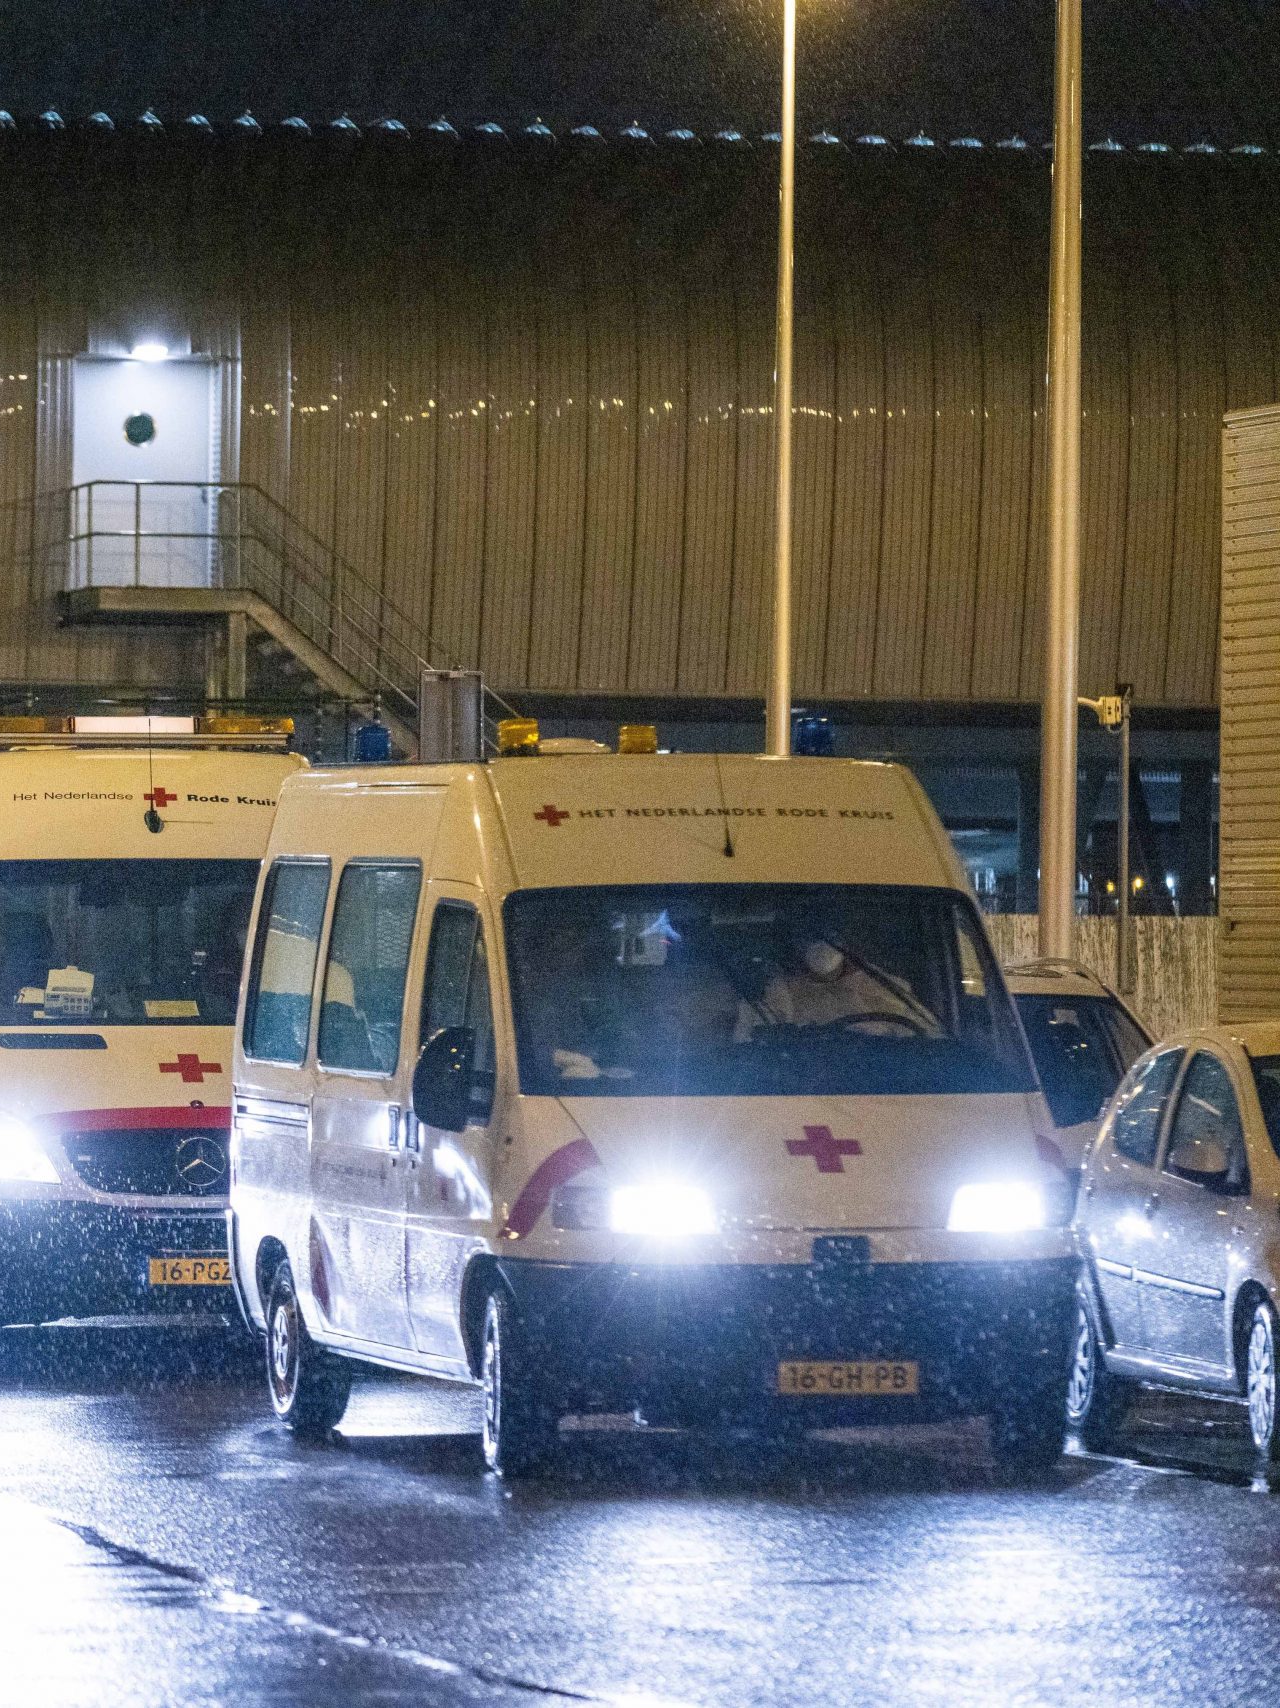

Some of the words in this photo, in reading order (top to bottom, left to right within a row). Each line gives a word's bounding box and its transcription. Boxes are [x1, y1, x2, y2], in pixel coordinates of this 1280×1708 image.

[13, 792, 38, 801] Het
[44, 791, 134, 801] Nederlandse
[187, 793, 230, 804] Rode
[236, 795, 277, 807] Kruis
[579, 808, 616, 819] HET
[625, 807, 768, 818] NEDERLANDSE
[775, 807, 830, 818] RODE
[838, 809, 895, 820] KRUIS
[160, 1261, 232, 1281] 16-PGZ
[787, 1365, 908, 1389] 16-GH-PB
